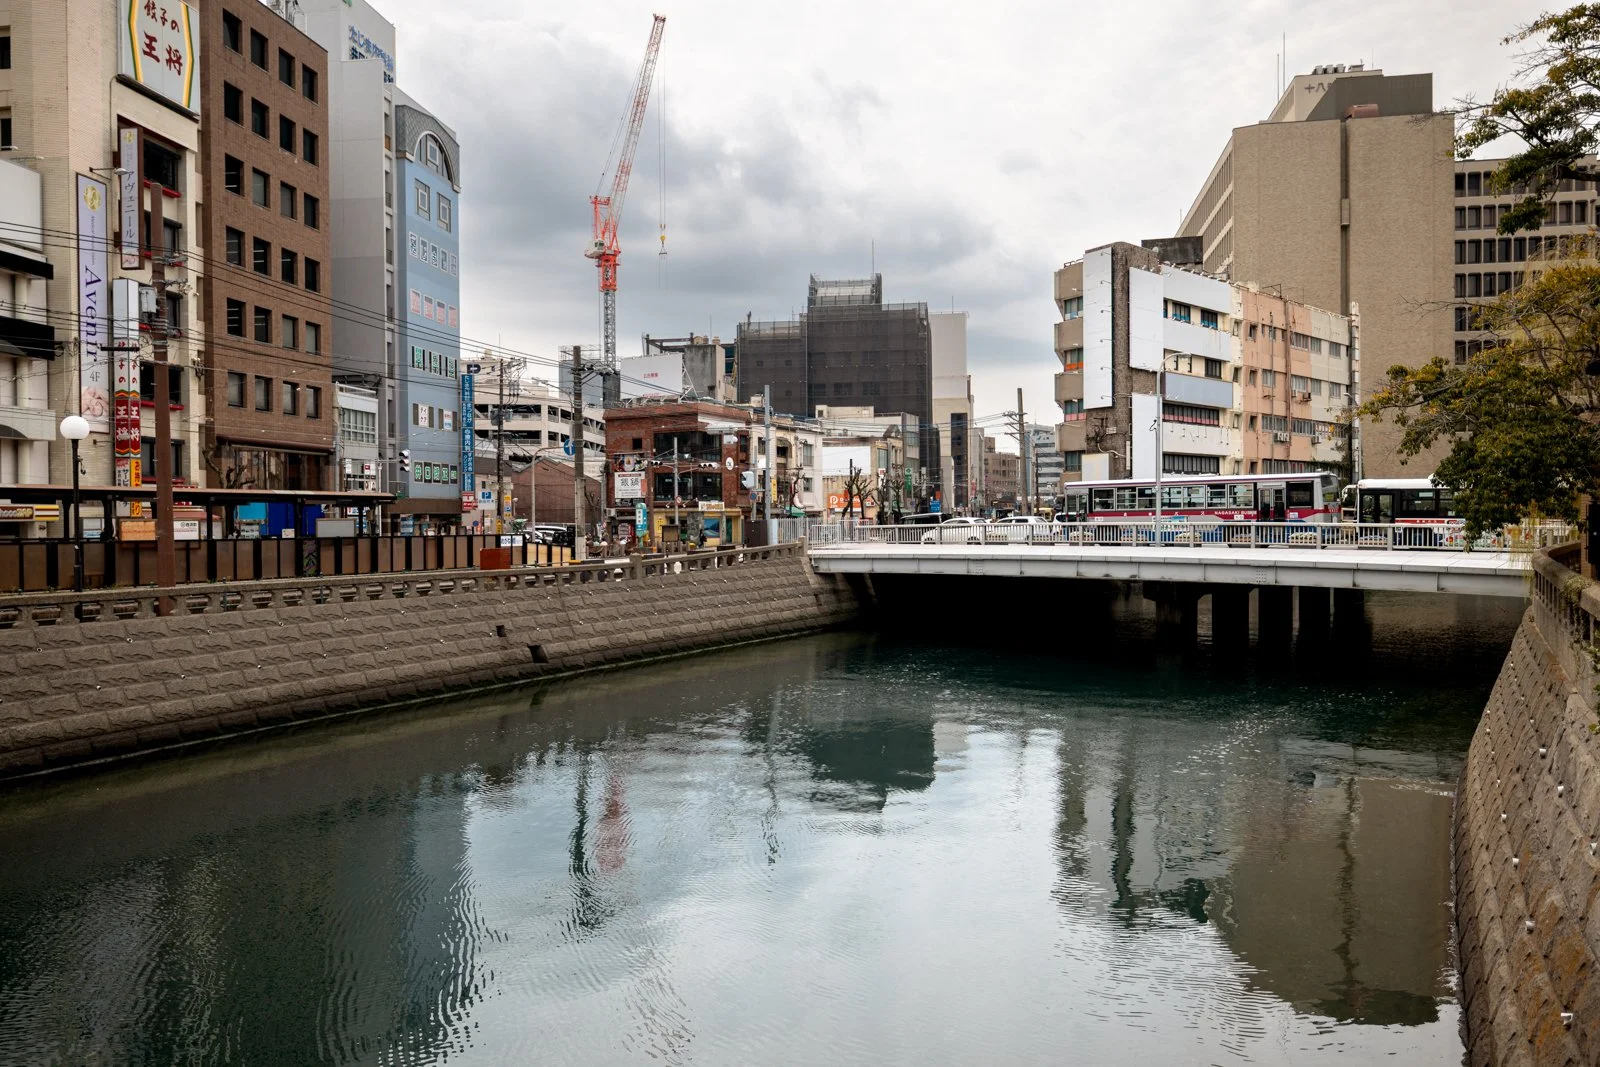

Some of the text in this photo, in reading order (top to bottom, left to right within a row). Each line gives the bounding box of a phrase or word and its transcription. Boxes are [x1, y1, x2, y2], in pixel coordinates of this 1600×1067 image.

[144, 0, 180, 33] 餃子の
[142, 30, 183, 76] 王将
[1304, 82, 1333, 94] 十八
[85, 264, 103, 362] Avenir
[89, 371, 101, 382] 4F
